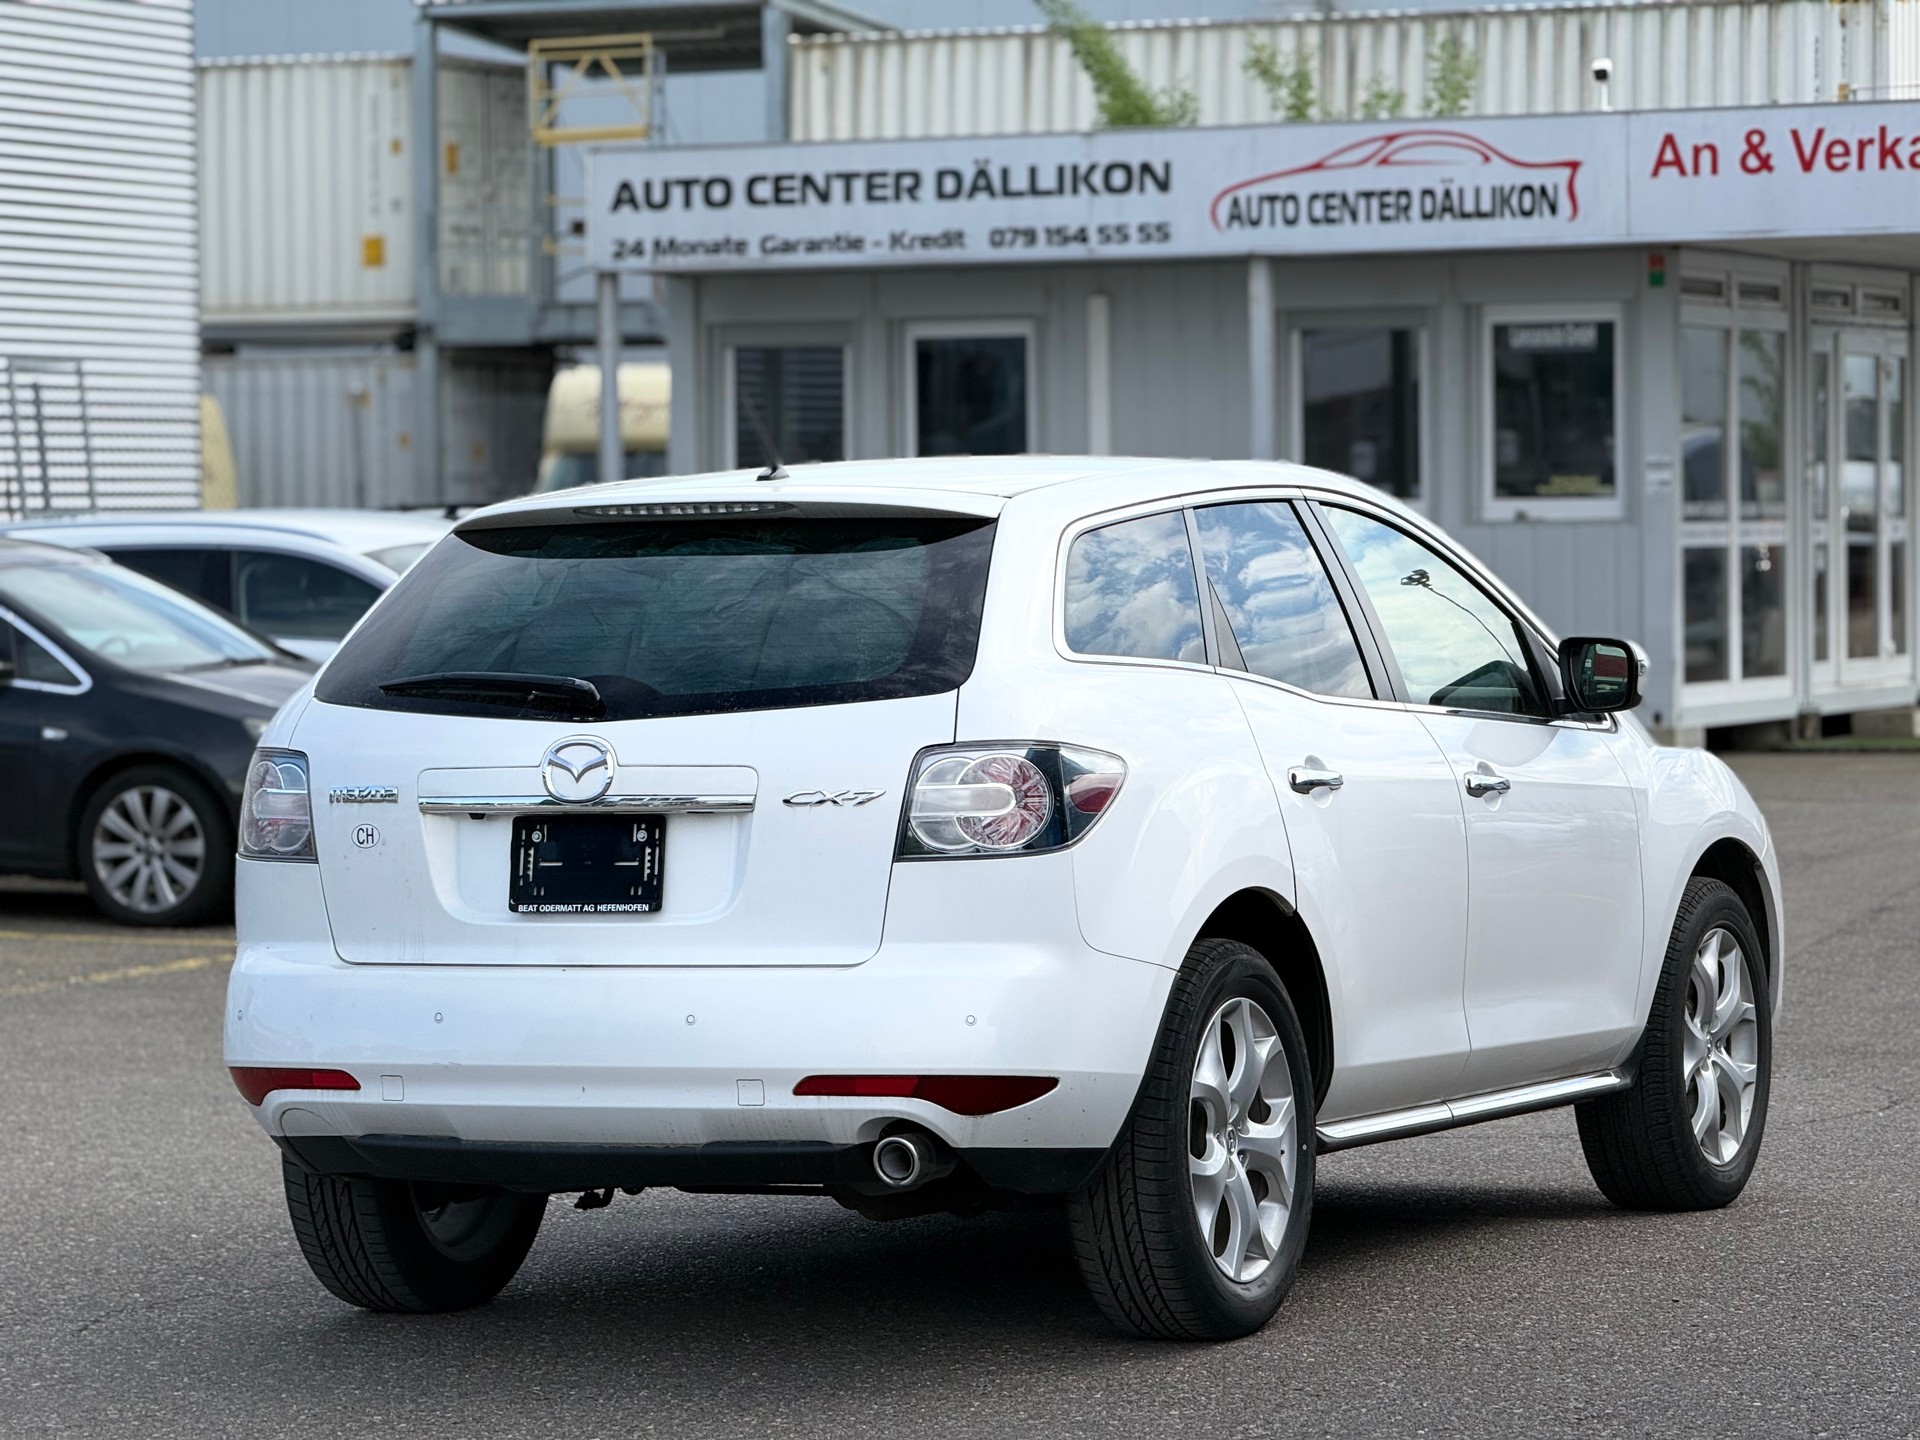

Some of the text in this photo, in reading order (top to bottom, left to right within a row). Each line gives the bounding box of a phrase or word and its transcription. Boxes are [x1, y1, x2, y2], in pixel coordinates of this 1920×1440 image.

[1650, 132, 1718, 178] An
[1739, 128, 1775, 174] &
[609, 158, 1171, 213] AUTO CENTER DÄLLIKON
[1226, 177, 1558, 229] AUTO CENTER DÄLLIKON
[612, 238, 645, 260] 24
[652, 235, 747, 258] Monate
[760, 231, 865, 254] Garantie
[889, 229, 966, 251] Kredit
[989, 226, 1038, 249] 079
[1044, 224, 1089, 247] 154
[782, 789, 887, 807] CX-7
[356, 827, 375, 845] CH
[517, 903, 649, 913] BEAT ODERMATT AG HEFENHOFEN
